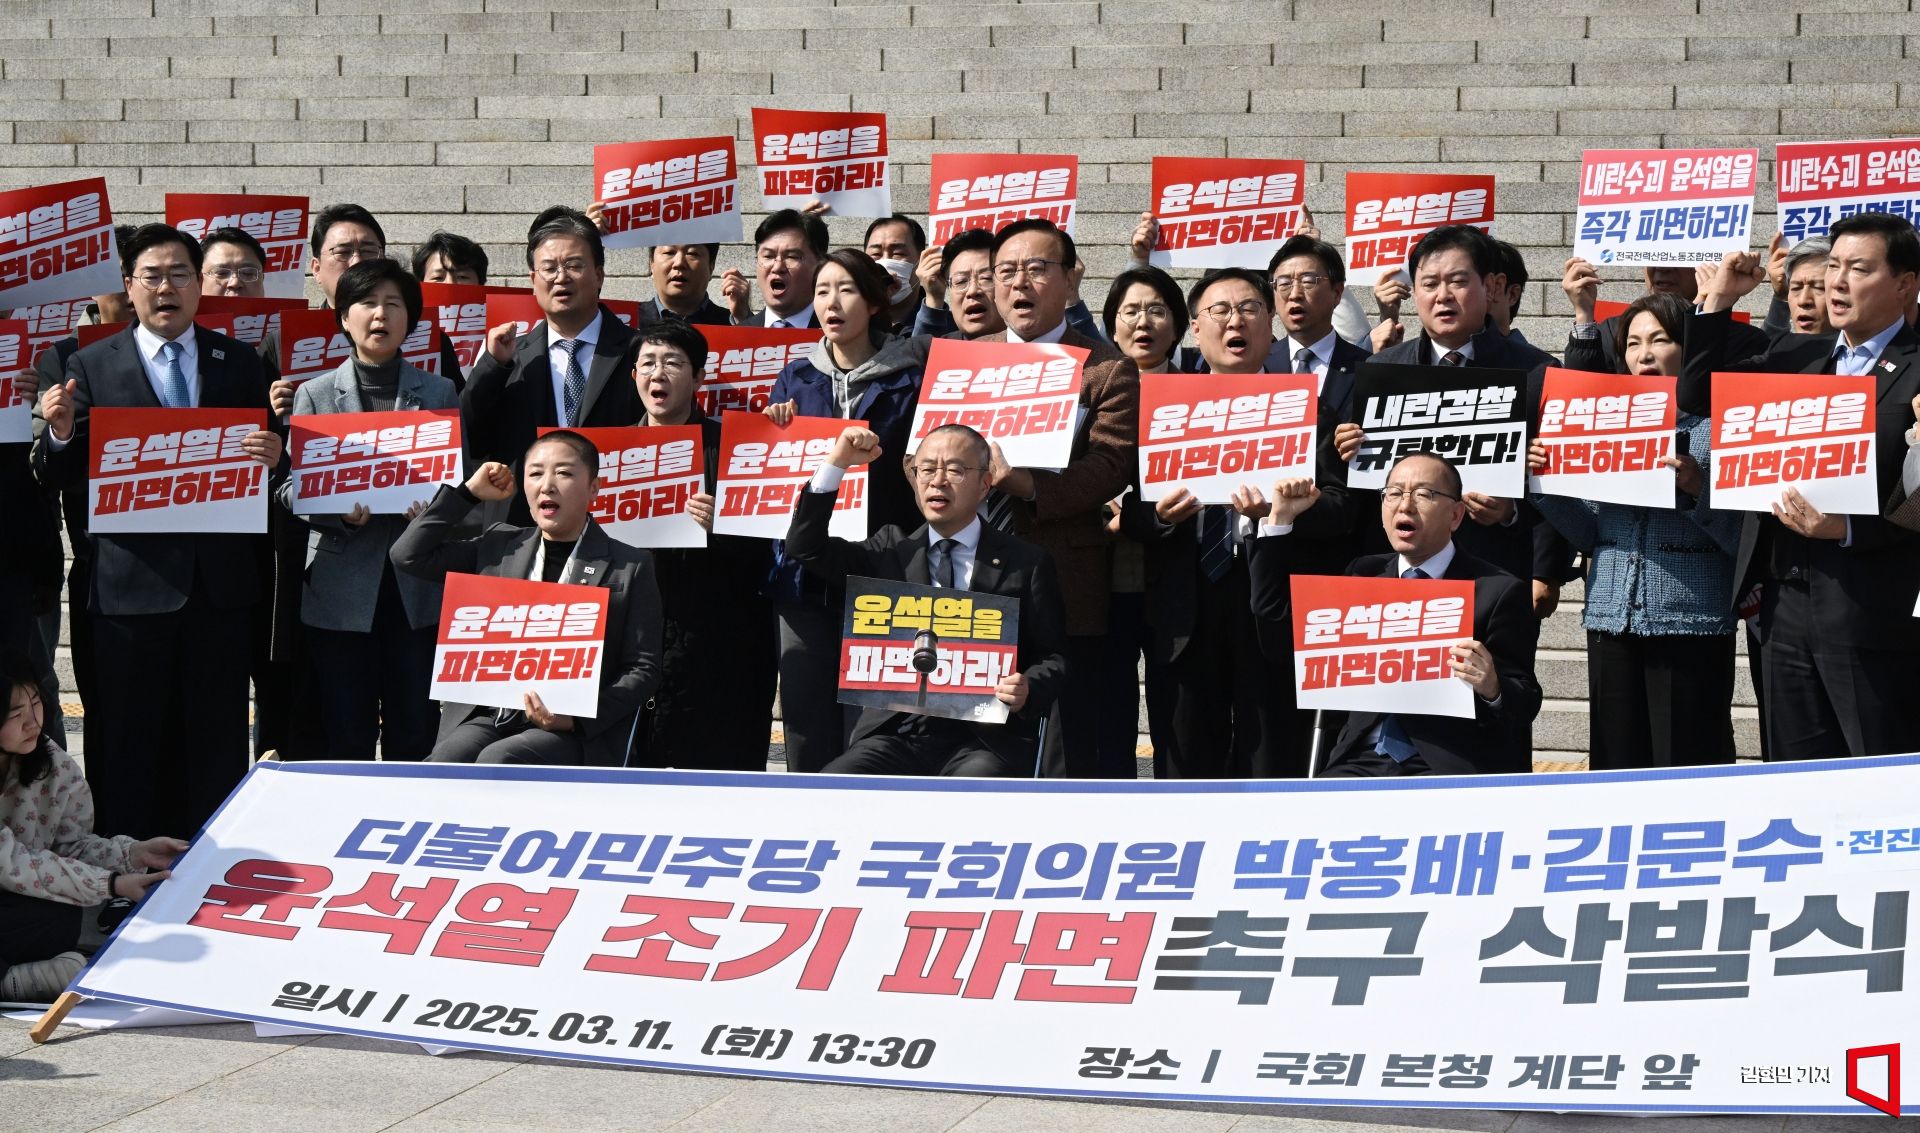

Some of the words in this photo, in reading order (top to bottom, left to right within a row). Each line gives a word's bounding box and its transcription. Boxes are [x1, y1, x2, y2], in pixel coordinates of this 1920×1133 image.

[762, 125, 880, 162] 윤석열을
[601, 149, 728, 200] 윤석열을
[764, 161, 884, 196] 파면하라!
[937, 168, 1071, 210] 윤석열을
[1159, 173, 1297, 214] 윤석열을
[1583, 160, 1667, 197] 내란수괴
[1670, 154, 1754, 192] 윤석열을
[1781, 154, 1860, 193] 내란수괴
[602, 184, 734, 234] 파면하라!
[1155, 210, 1299, 251] 파면하라!
[1352, 188, 1487, 231] 윤석열을
[1581, 210, 1631, 244] 즉각
[1636, 204, 1749, 242] 파면하라!
[1784, 206, 1831, 241] 즉각
[1616, 250, 1723, 263] 전국전력산업노동조합연맹
[929, 357, 1077, 400] 윤석열을
[1149, 389, 1310, 440] 윤석열을
[1362, 386, 1517, 429] 내란검찰
[1541, 391, 1668, 433] 윤석열을
[1719, 392, 1866, 444] 윤석열을
[100, 423, 261, 472] 윤석열을
[301, 420, 452, 465] 윤석열을
[728, 437, 860, 475] 윤석열
[1145, 432, 1311, 484] 파면하라!
[1356, 431, 1522, 471] 규탄한다!
[1533, 436, 1670, 476] 파면하라!
[297, 453, 457, 500] 파면하라!
[1715, 439, 1869, 490] 파면하라!
[94, 465, 263, 516] 파면하라!
[448, 602, 601, 640] 윤석열을
[852, 594, 1003, 640] 윤석열을
[1304, 596, 1465, 645] 윤석열을
[437, 647, 599, 682] 파면하라!
[846, 645, 1013, 687] 파면하라!
[334, 818, 840, 893] 더불어민주당
[857, 840, 1206, 901] 국회의원
[187, 858, 579, 967] 윤석열
[583, 894, 863, 991] 조기
[1478, 890, 1910, 1005] 삭발식
[271, 980, 378, 1018] 일시
[700, 1024, 793, 1060] (화)
[806, 1032, 936, 1069] 13:30
[1077, 1046, 1182, 1081] 장소
[1255, 1052, 1366, 1087] 국회
[1380, 1053, 1493, 1089] 본청
[1507, 1054, 1625, 1091] 계단
[1641, 1053, 1701, 1091] 앞
